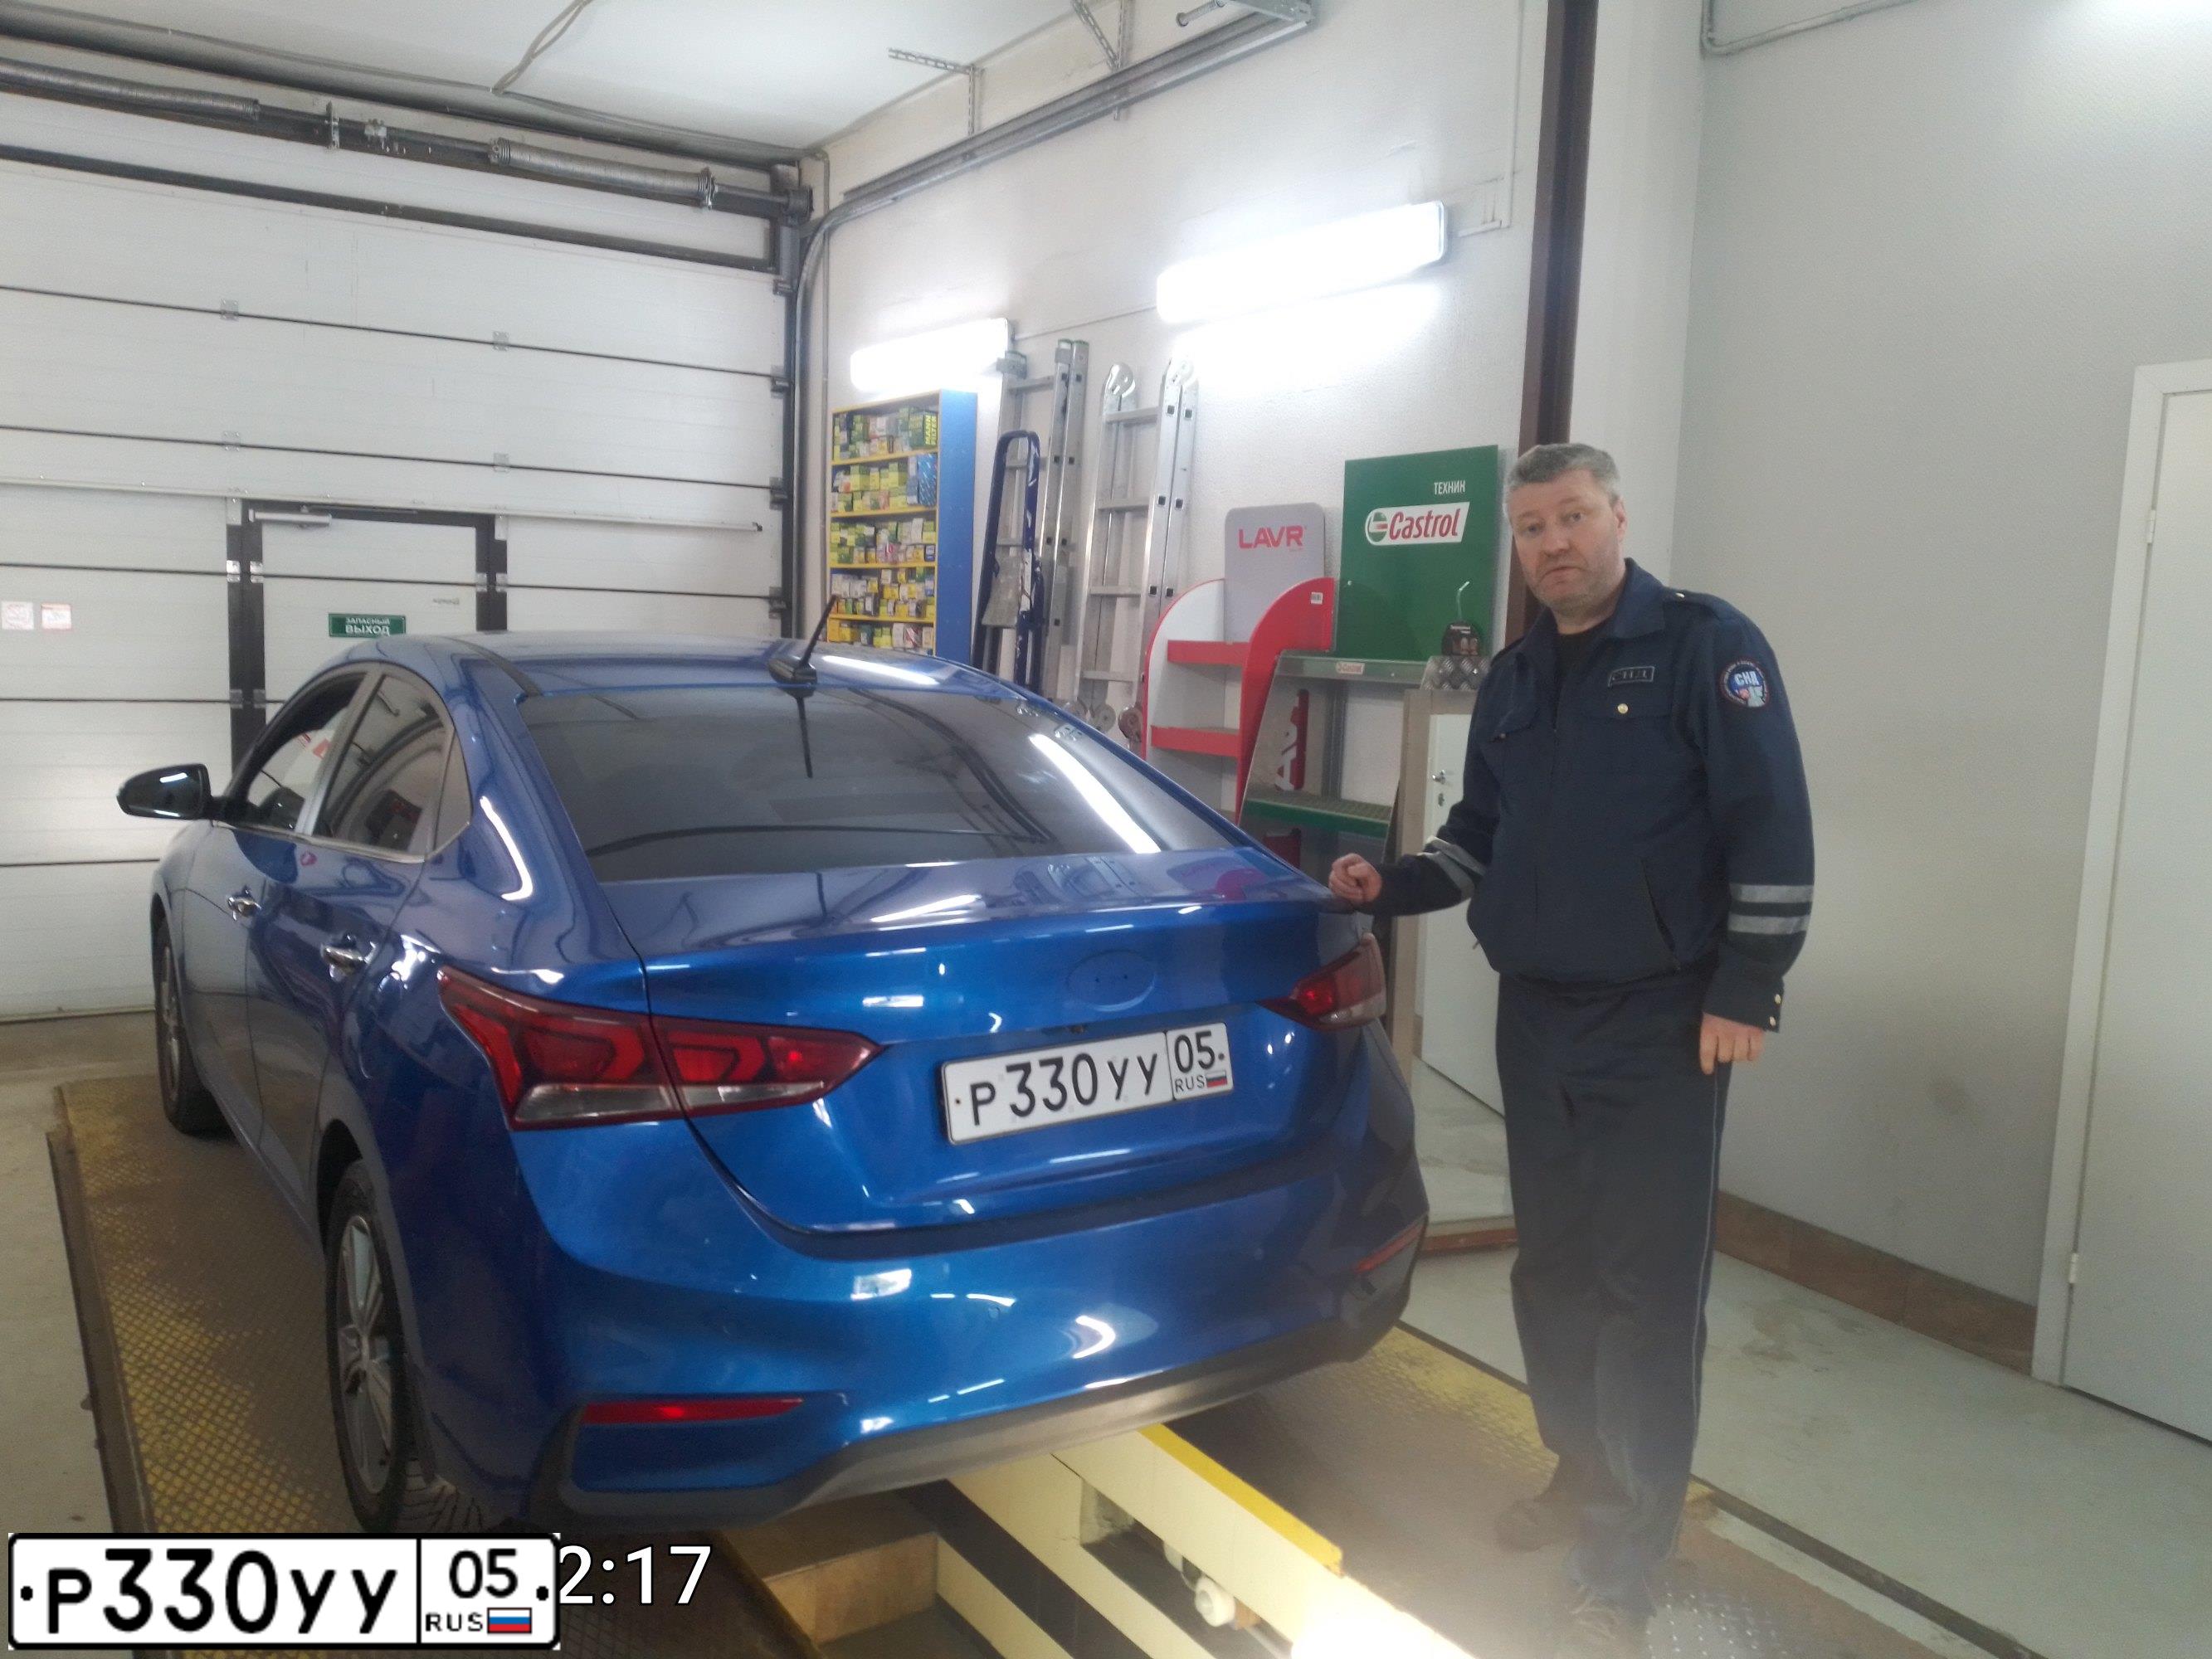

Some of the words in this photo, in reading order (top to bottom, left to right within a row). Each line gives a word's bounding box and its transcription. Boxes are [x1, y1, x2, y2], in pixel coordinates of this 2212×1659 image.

[1388, 508, 1461, 541] Castrol
[1238, 525, 1303, 549] LAVR
[345, 624, 391, 637] ВЫХОД
[1174, 1030, 1216, 1074] 05
[1174, 1074, 1206, 1093] RUS
